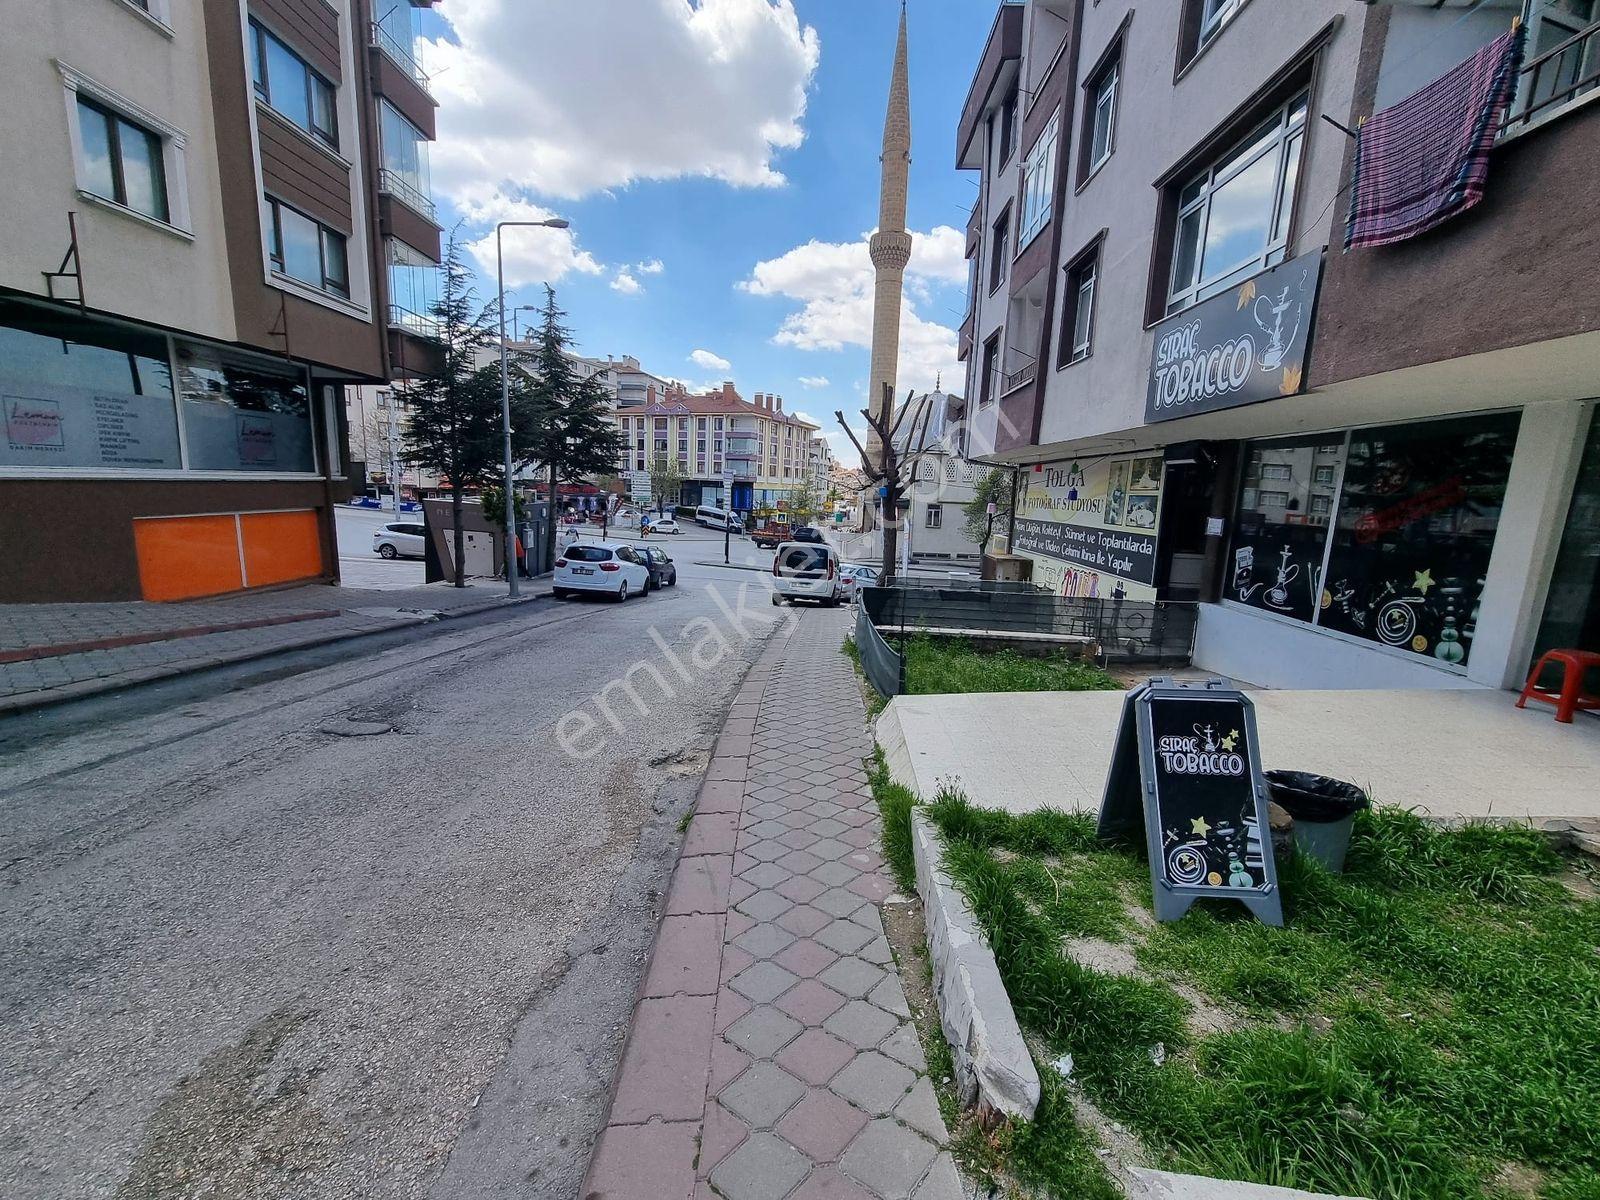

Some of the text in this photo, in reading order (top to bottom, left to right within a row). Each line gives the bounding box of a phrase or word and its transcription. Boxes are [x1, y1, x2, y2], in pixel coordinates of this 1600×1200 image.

[1155, 338, 1253, 408] TOBACCO
[1045, 467, 1086, 488] TOLGA
[1087, 534, 1096, 544] ve
[1098, 531, 1153, 555] Toplantılarda
[1108, 552, 1134, 574] Yapılır
[1161, 752, 1245, 776] TOBACCO
